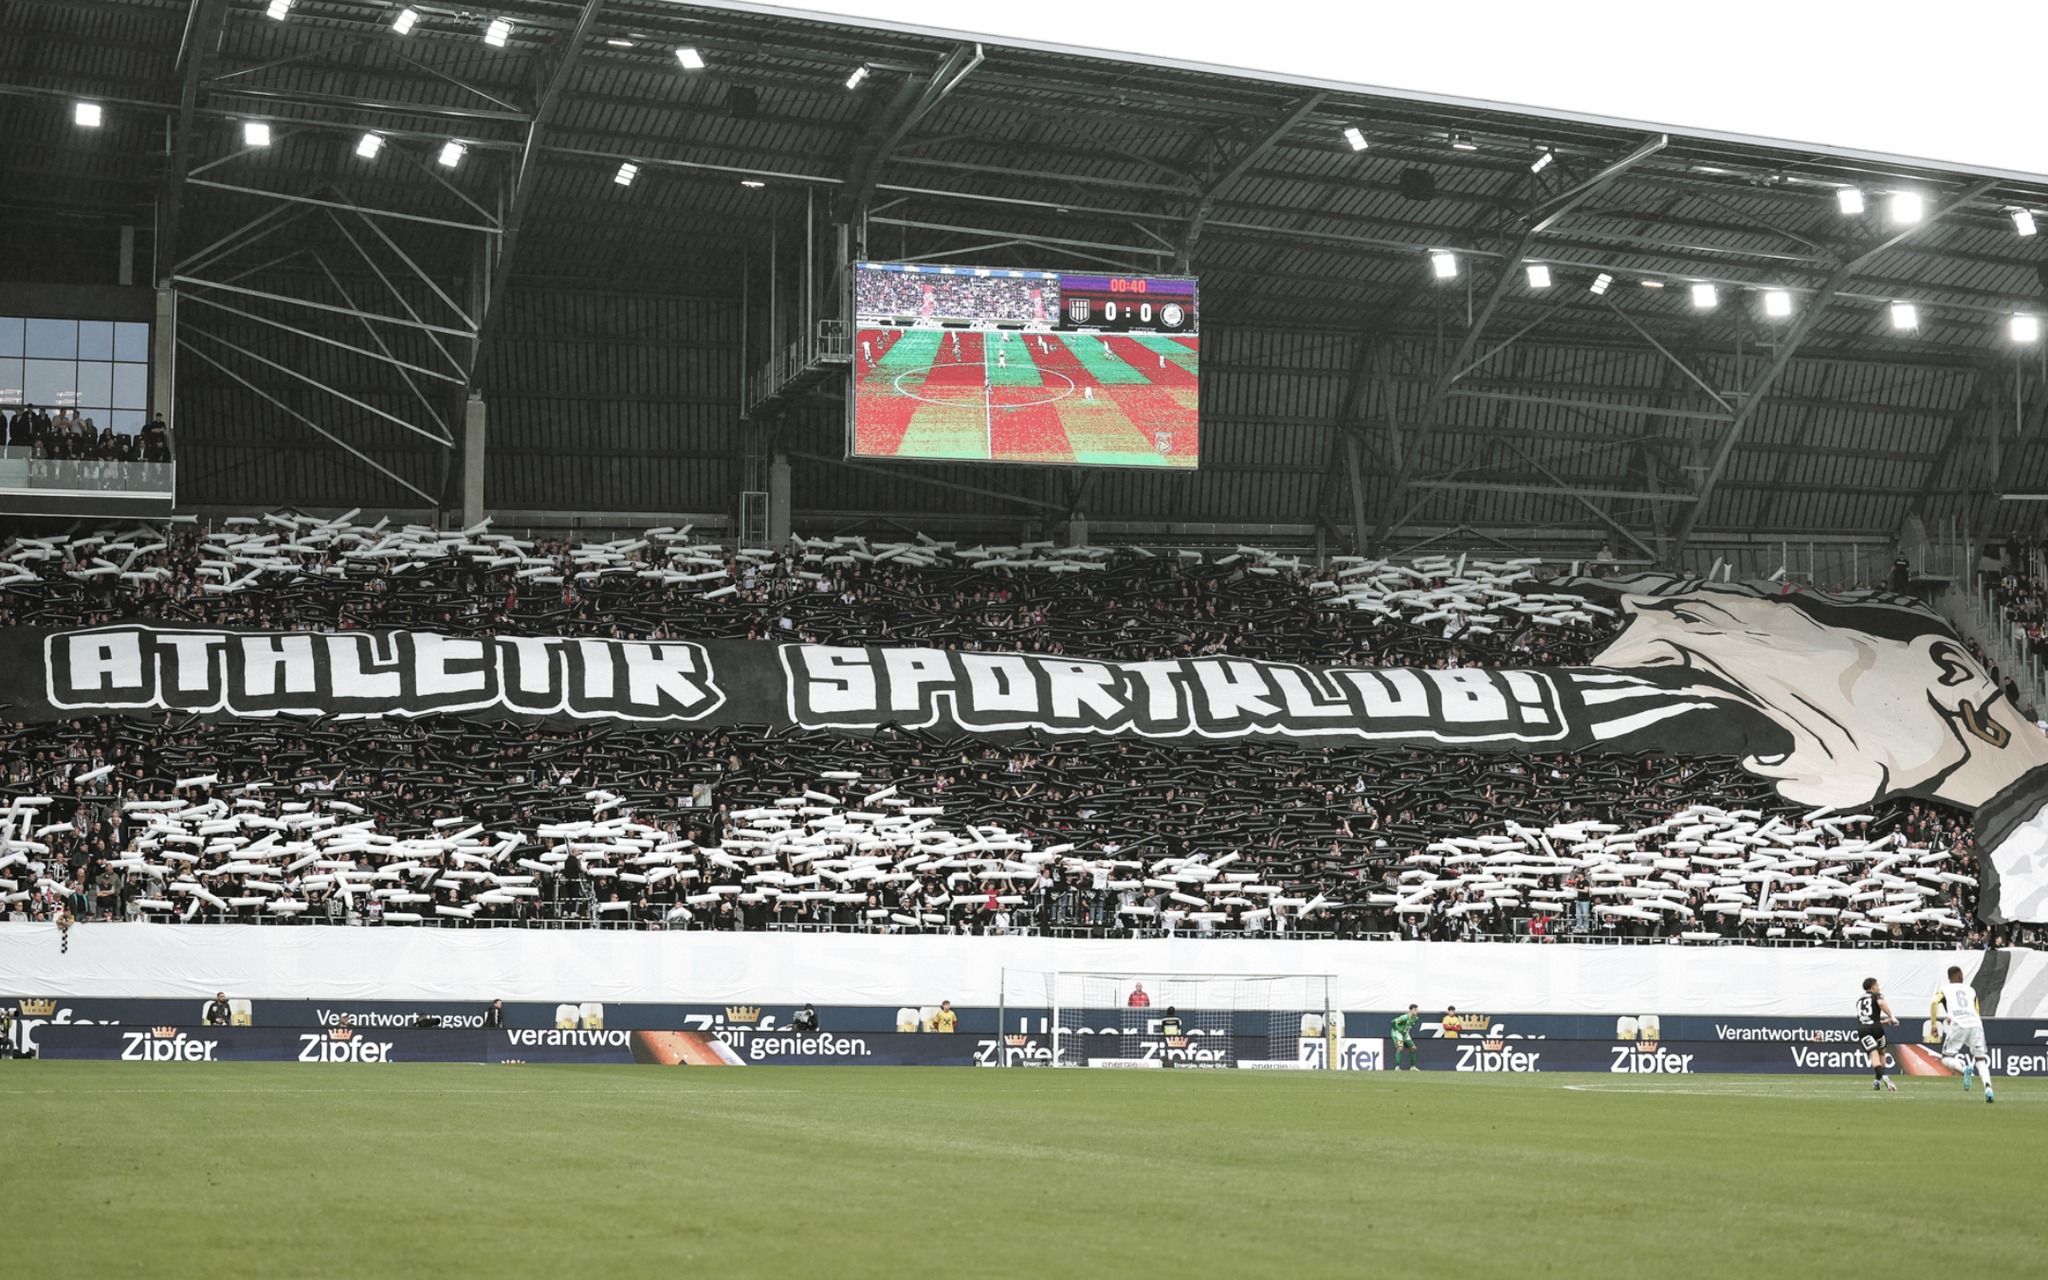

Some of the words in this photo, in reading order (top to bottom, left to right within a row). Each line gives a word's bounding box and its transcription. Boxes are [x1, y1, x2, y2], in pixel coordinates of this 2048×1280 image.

[1110, 279, 1146, 293] 00:40
[1105, 302, 1117, 320] 0
[1140, 303, 1152, 322] 0
[69, 631, 708, 709] ATHLETIK
[806, 644, 1548, 723] SPORTKLUB!
[121, 1032, 217, 1061] Zipfer
[299, 1034, 393, 1062] Zipfer
[750, 1033, 871, 1059] genießen.
[1303, 1042, 1381, 1070] Zifer
[1456, 1045, 1540, 1072] Zipfer
[1610, 1046, 1694, 1073] Zipfer
